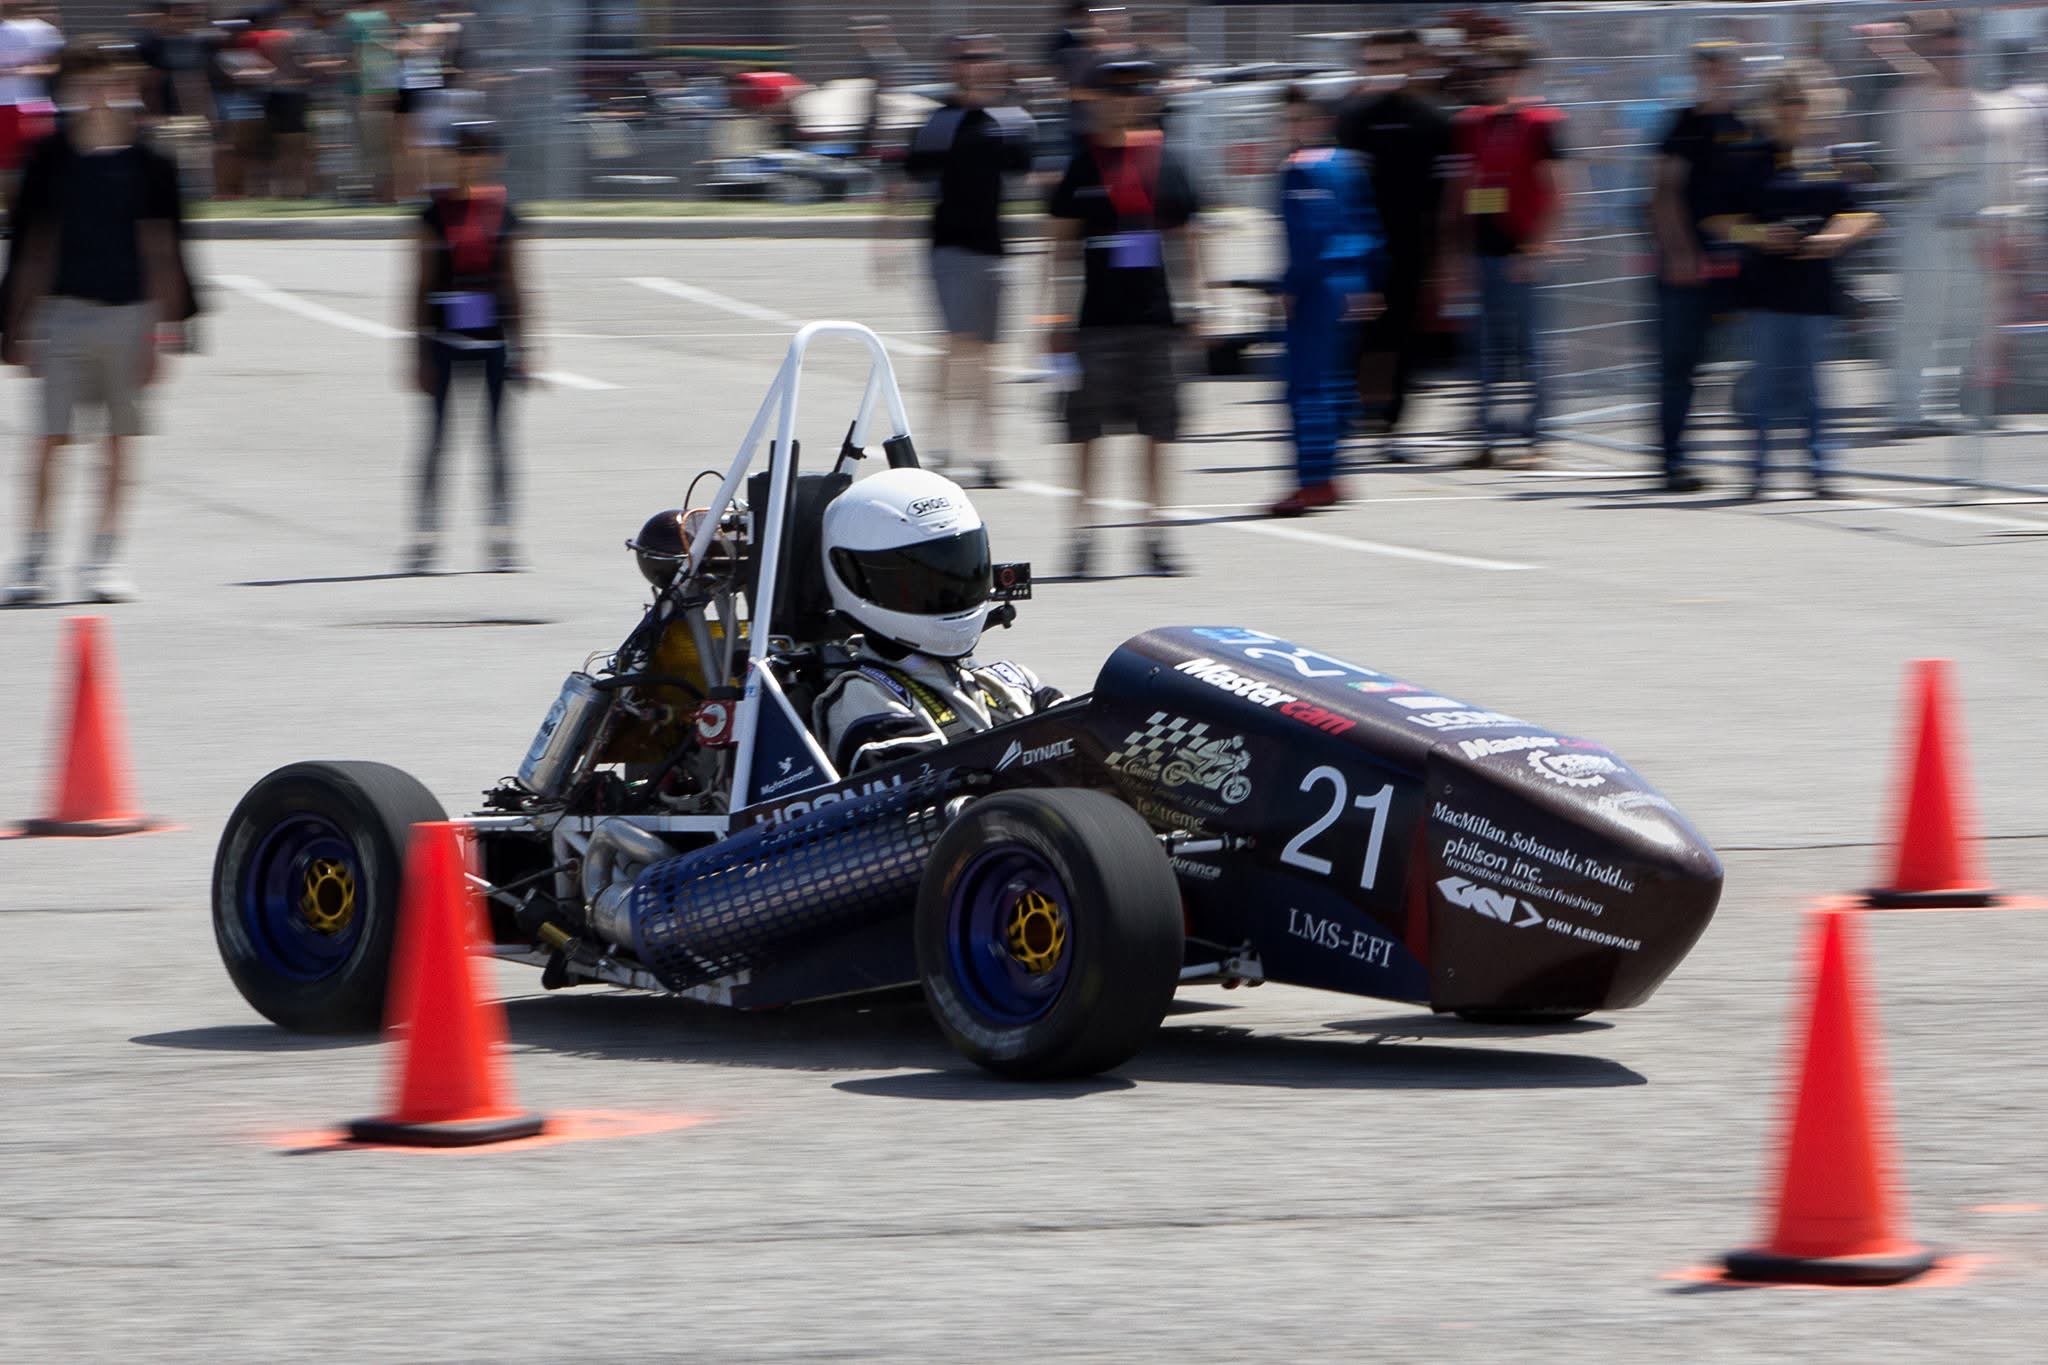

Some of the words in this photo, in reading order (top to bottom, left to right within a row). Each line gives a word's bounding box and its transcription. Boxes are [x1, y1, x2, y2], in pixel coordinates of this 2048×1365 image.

[1174, 657, 1357, 736] Mastercam
[1280, 765, 1395, 890] 21
[1442, 837, 1508, 871] philson
[1512, 857, 1544, 883] inc.
[1446, 855, 1502, 883] Innovative
[1501, 875, 1554, 900] anodized
[1554, 889, 1605, 917] finishing
[1509, 831, 1577, 871] Sobanski
[1576, 862, 1583, 873] &
[1584, 858, 1621, 888] Todd
[1287, 906, 1395, 968] LMS-EFI
[1546, 918, 1573, 934] GKN
[1572, 926, 1641, 951] AEROSPACE
